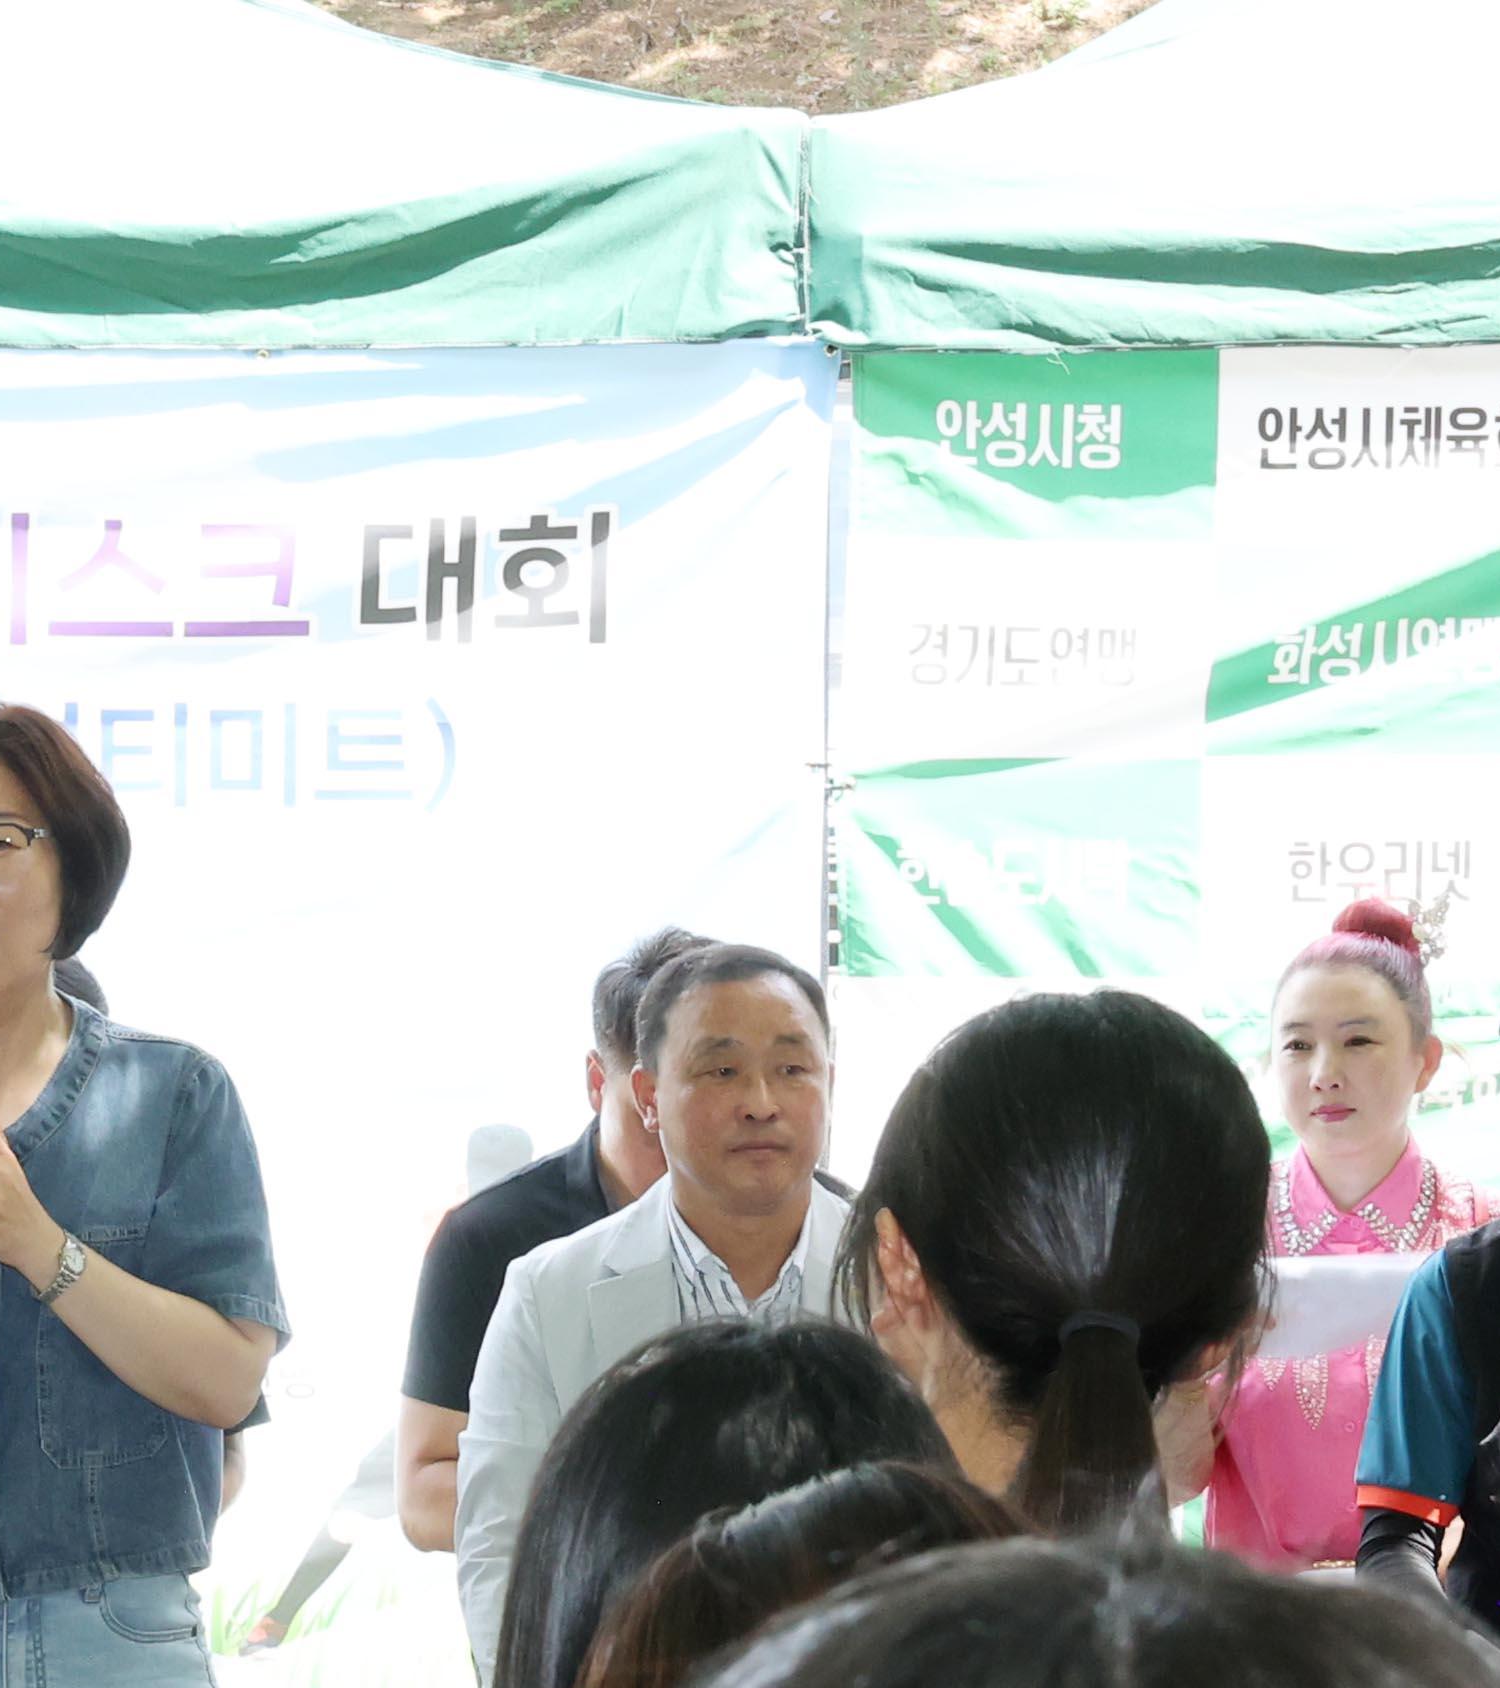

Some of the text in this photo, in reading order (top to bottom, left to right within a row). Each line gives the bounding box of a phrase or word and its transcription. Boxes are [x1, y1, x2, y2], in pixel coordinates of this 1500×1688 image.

[936, 400, 1122, 470] 안성시청
[358, 510, 613, 645] 대회
[907, 622, 1137, 689] 경기도연맹
[62, 697, 458, 813] 티미트)
[1288, 838, 1472, 905] 한우리넷
